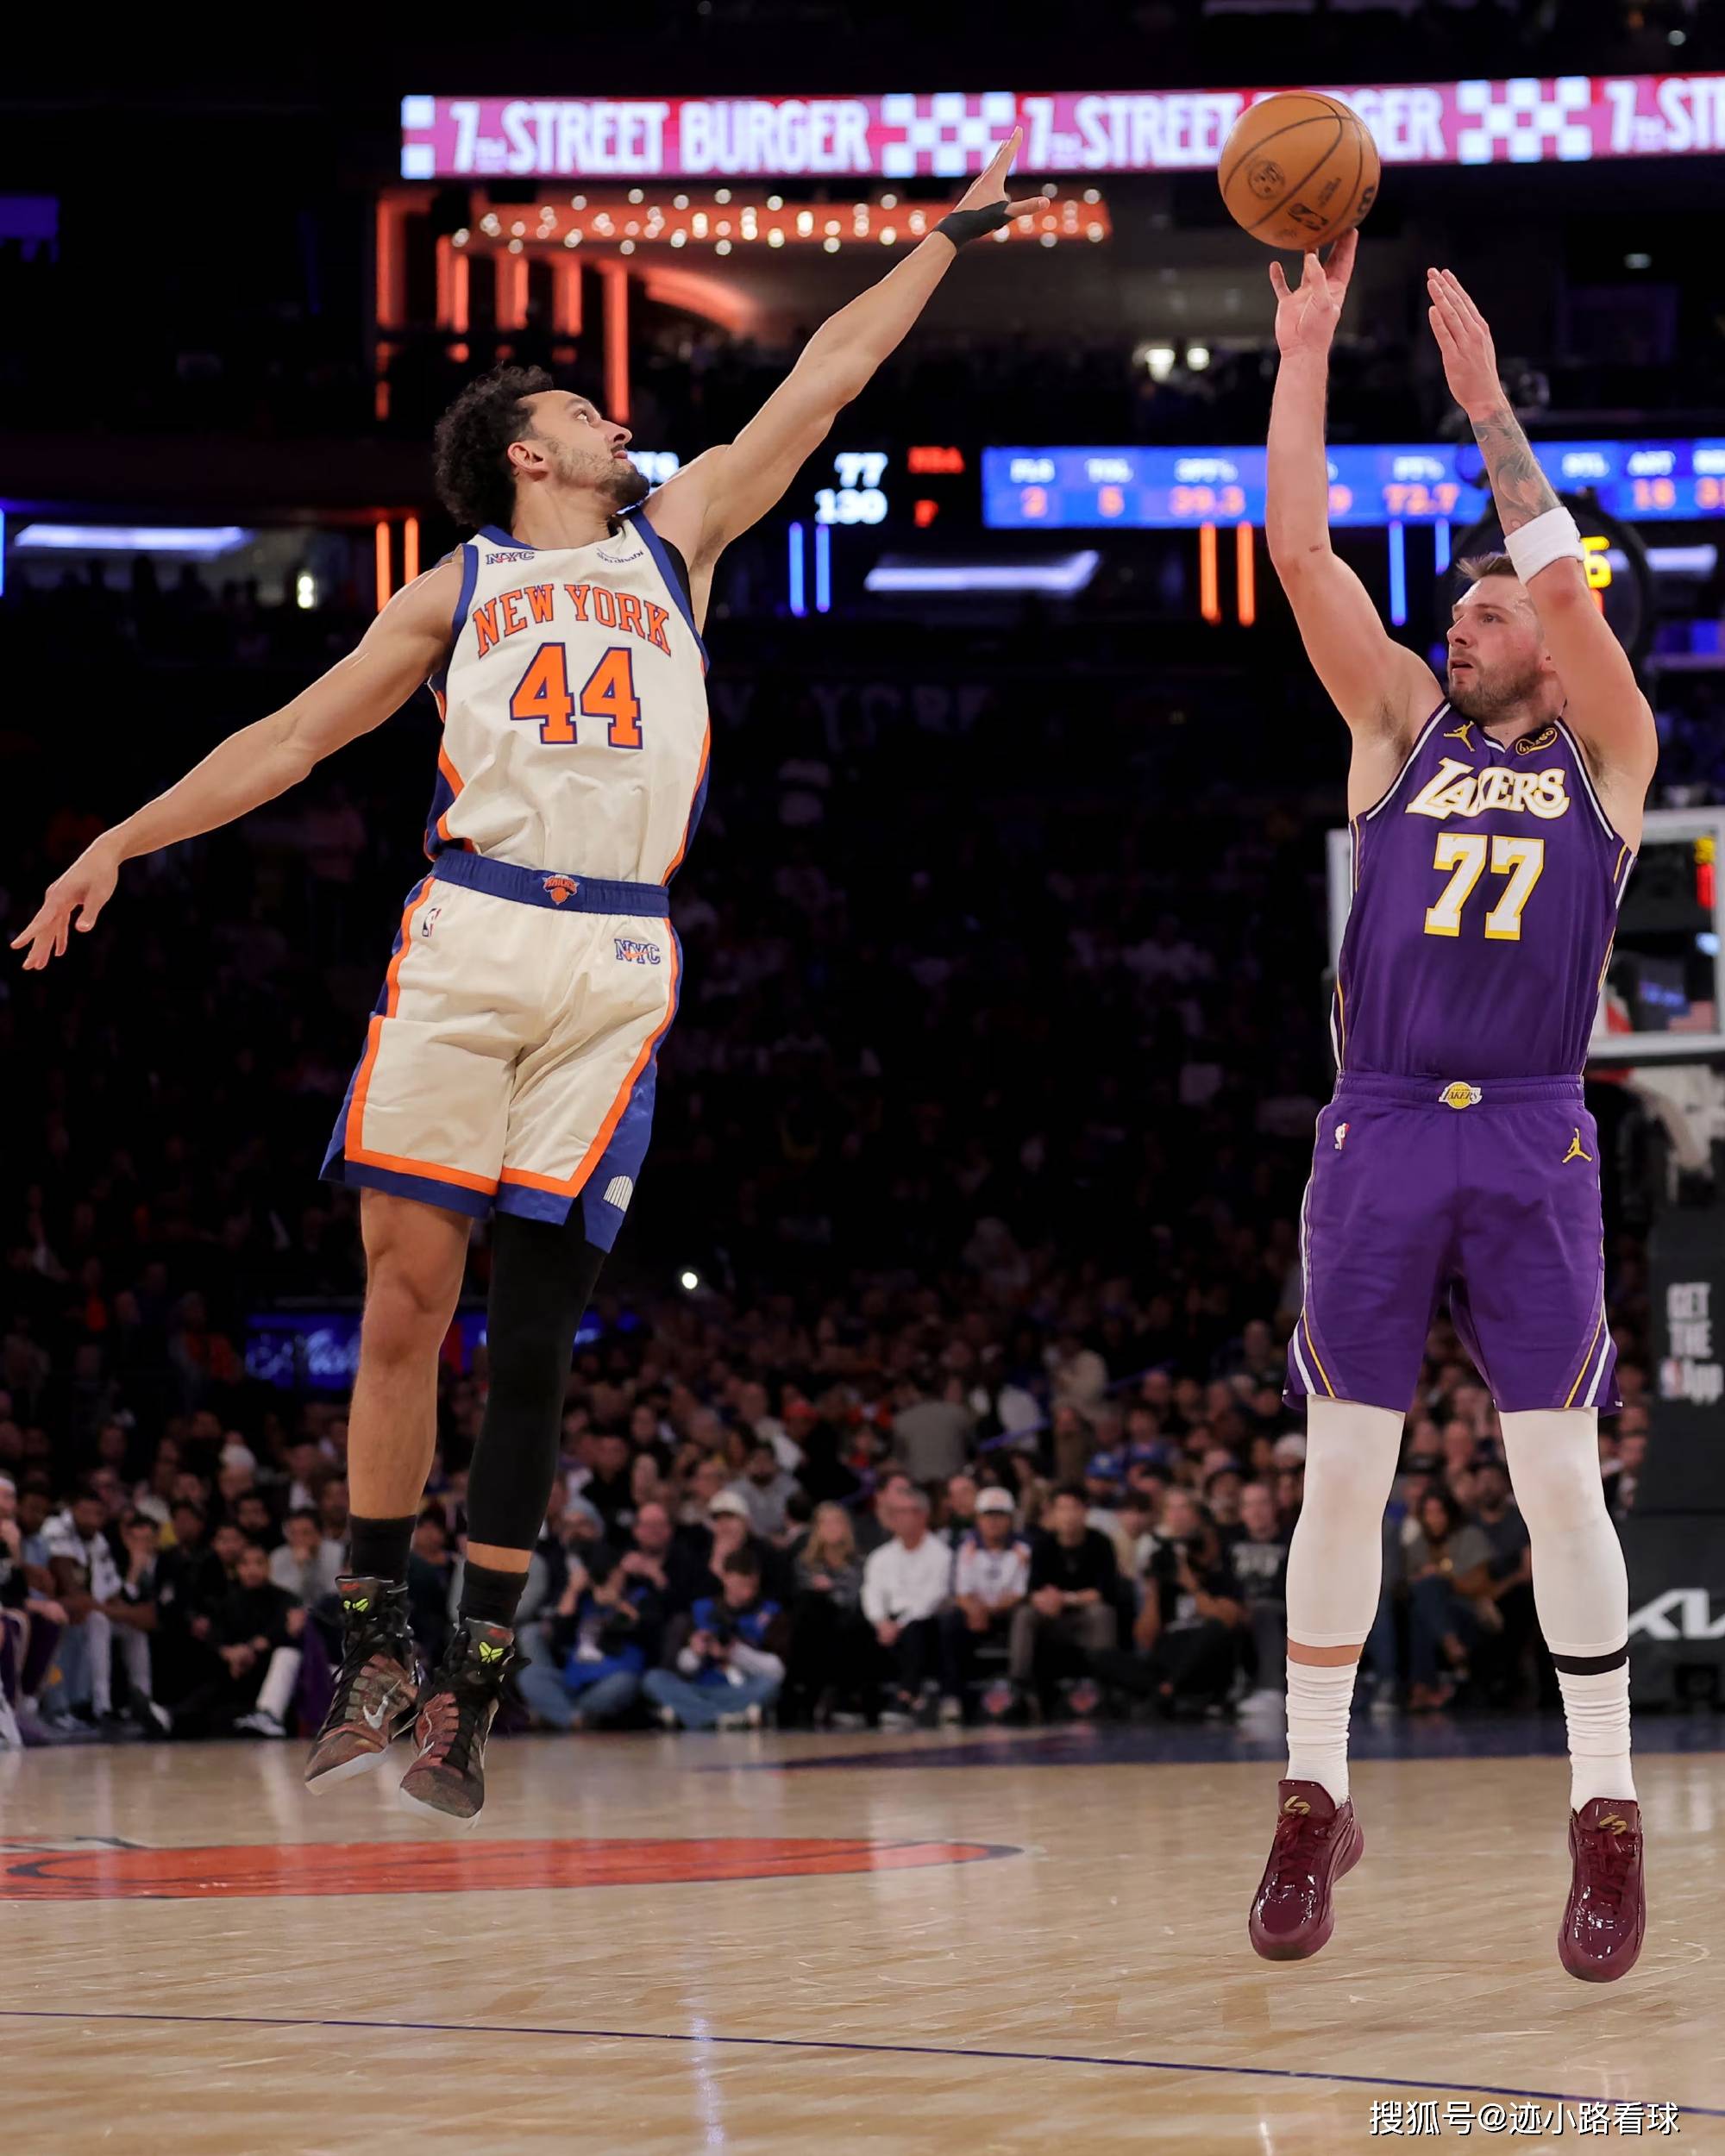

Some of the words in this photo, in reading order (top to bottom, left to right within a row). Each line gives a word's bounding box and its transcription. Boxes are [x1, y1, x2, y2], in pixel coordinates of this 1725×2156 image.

[501, 100, 668, 174] STREET
[680, 98, 873, 174] BURGER
[1075, 93, 1242, 169] STREET
[834, 452, 888, 487] 77
[485, 551, 536, 565] NYC
[473, 583, 555, 659] NEW
[564, 583, 671, 657] YORK
[509, 642, 643, 749] 44
[1405, 757, 1570, 820] LAKERS
[1424, 832, 1545, 941] 77
[614, 938, 661, 964] NYC
